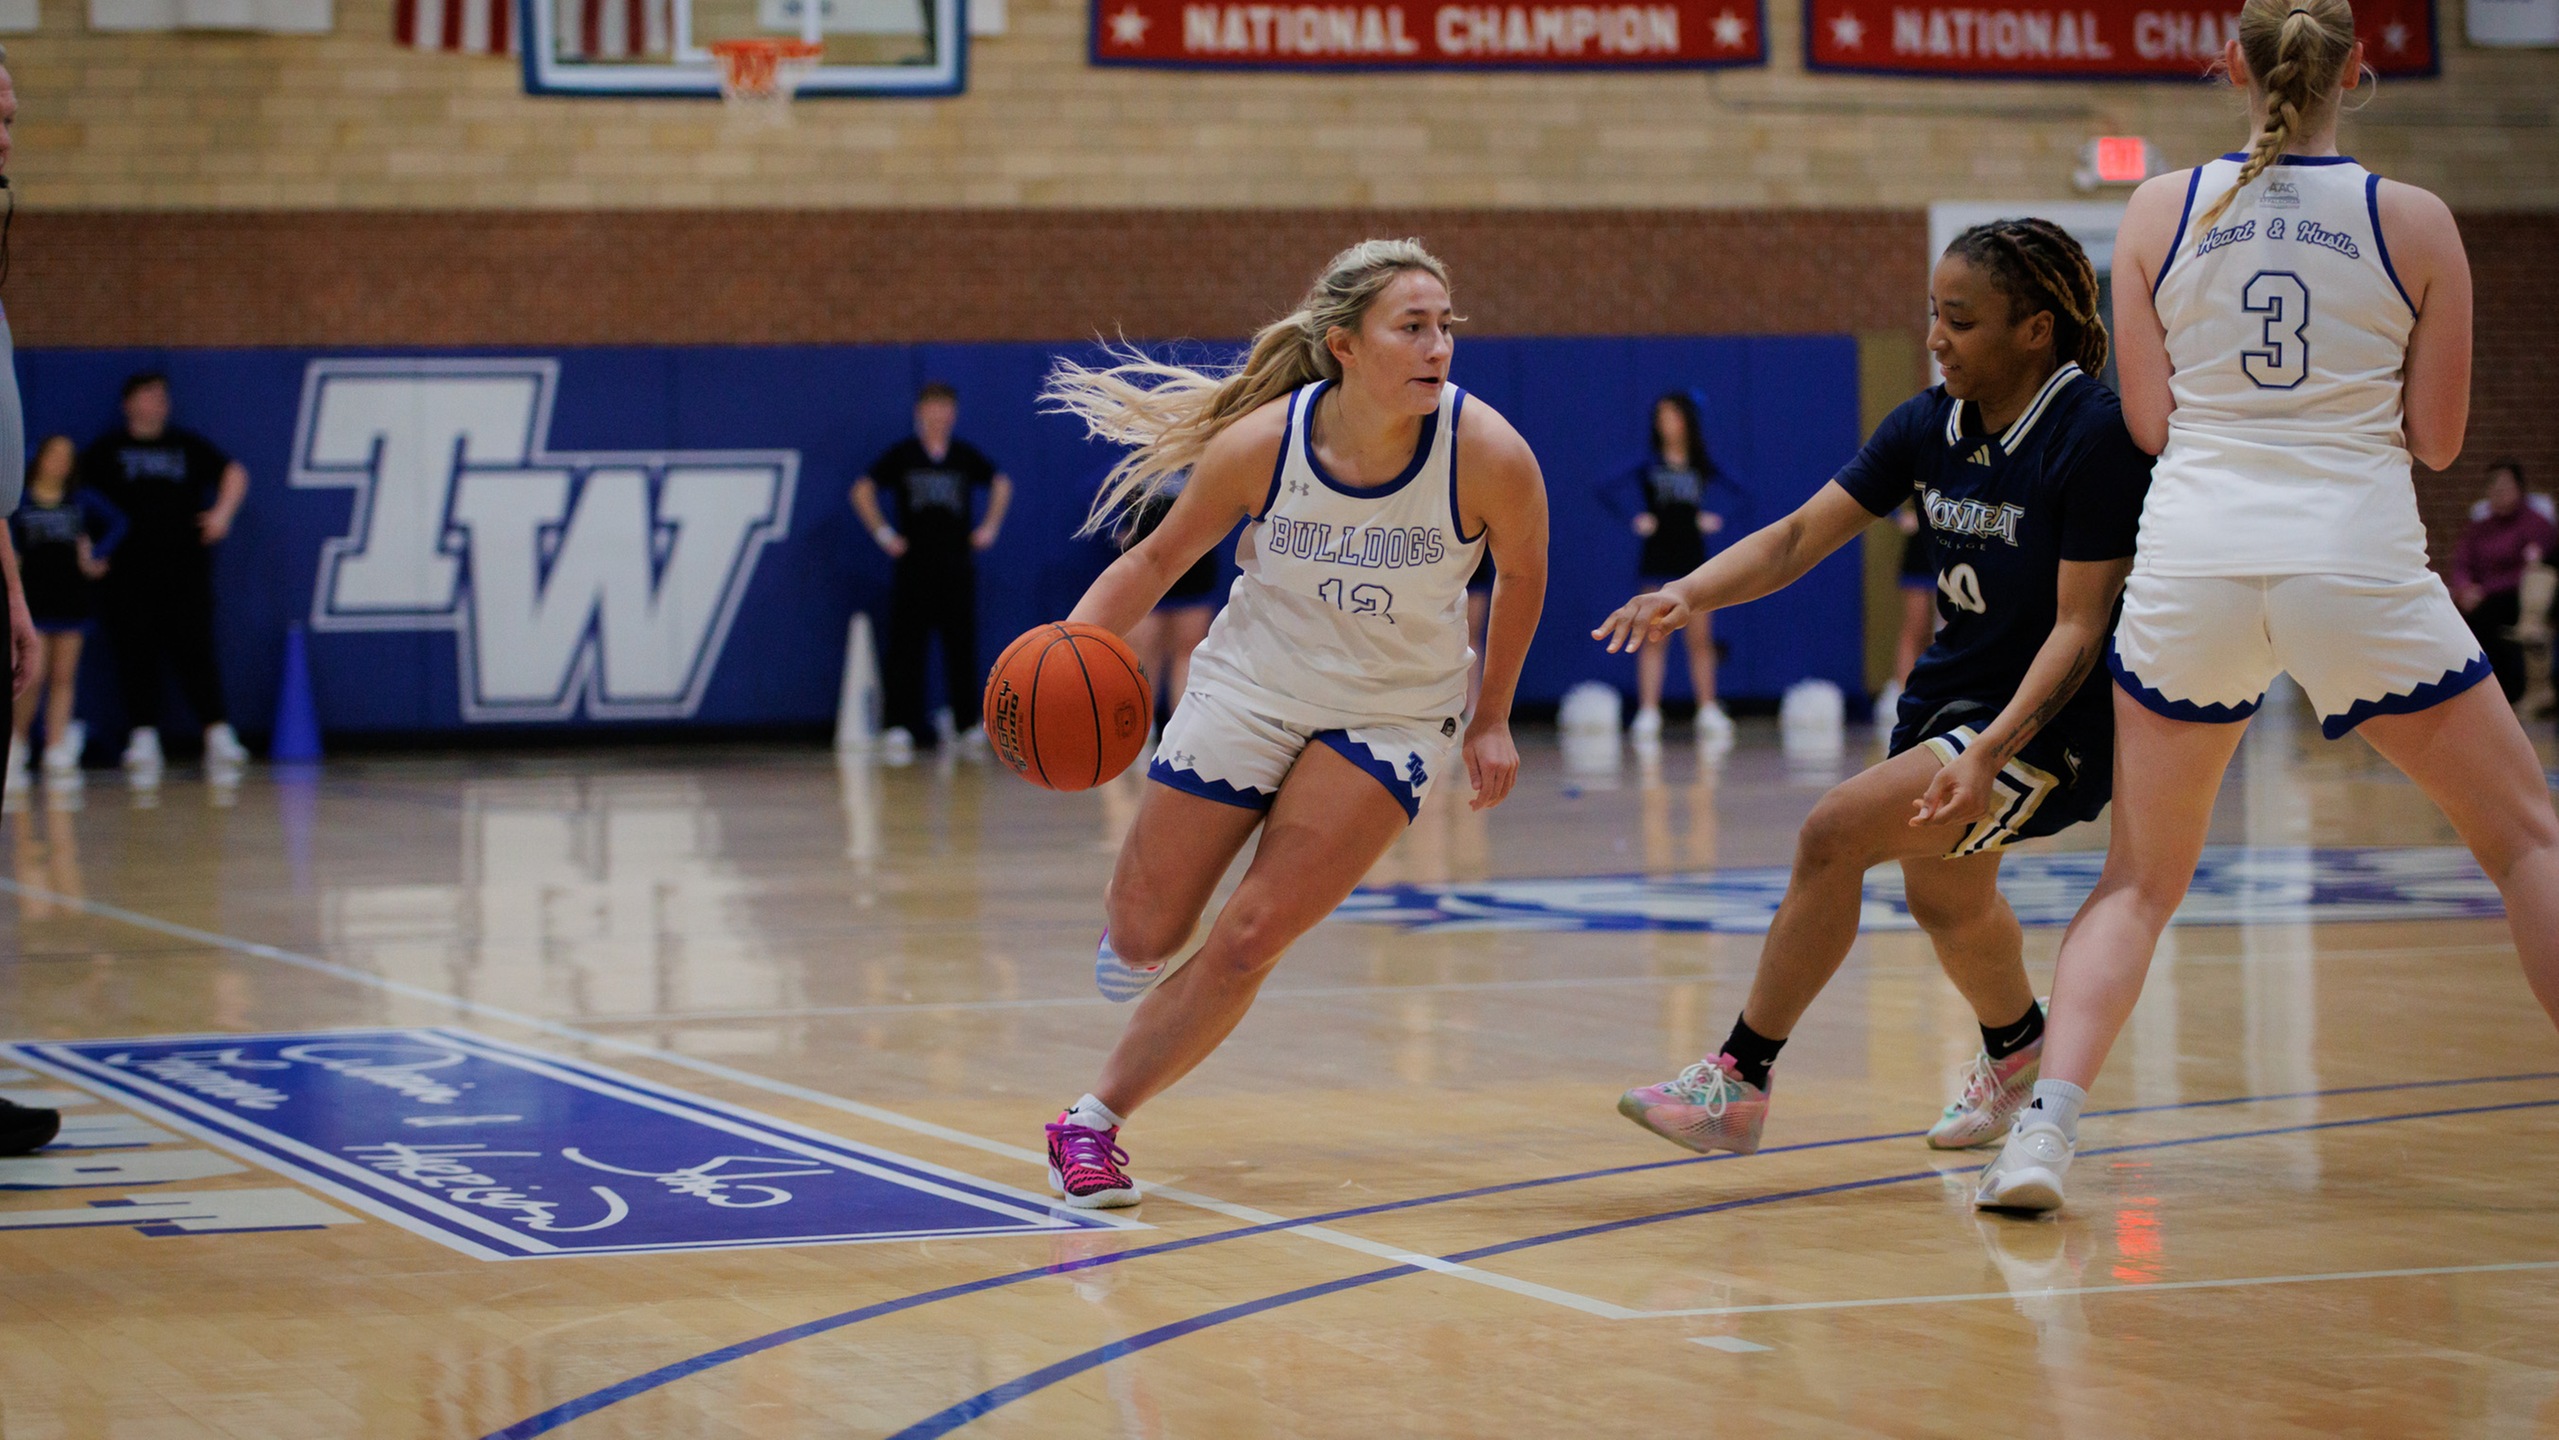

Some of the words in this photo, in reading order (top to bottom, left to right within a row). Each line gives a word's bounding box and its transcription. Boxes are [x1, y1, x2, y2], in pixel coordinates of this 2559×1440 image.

[1183, 4, 1419, 53] NATIONAL
[1434, 4, 1680, 53] CHAMPION
[1892, 9, 2113, 59] NATIONAL
[2197, 220, 2256, 258] Heart
[2267, 217, 2285, 239] &
[2297, 220, 2360, 259] Hustle
[2241, 270, 2310, 391] 3
[288, 357, 800, 721] TW
[1270, 515, 1444, 568] BULLDOGS
[1405, 751, 1428, 788] TW
